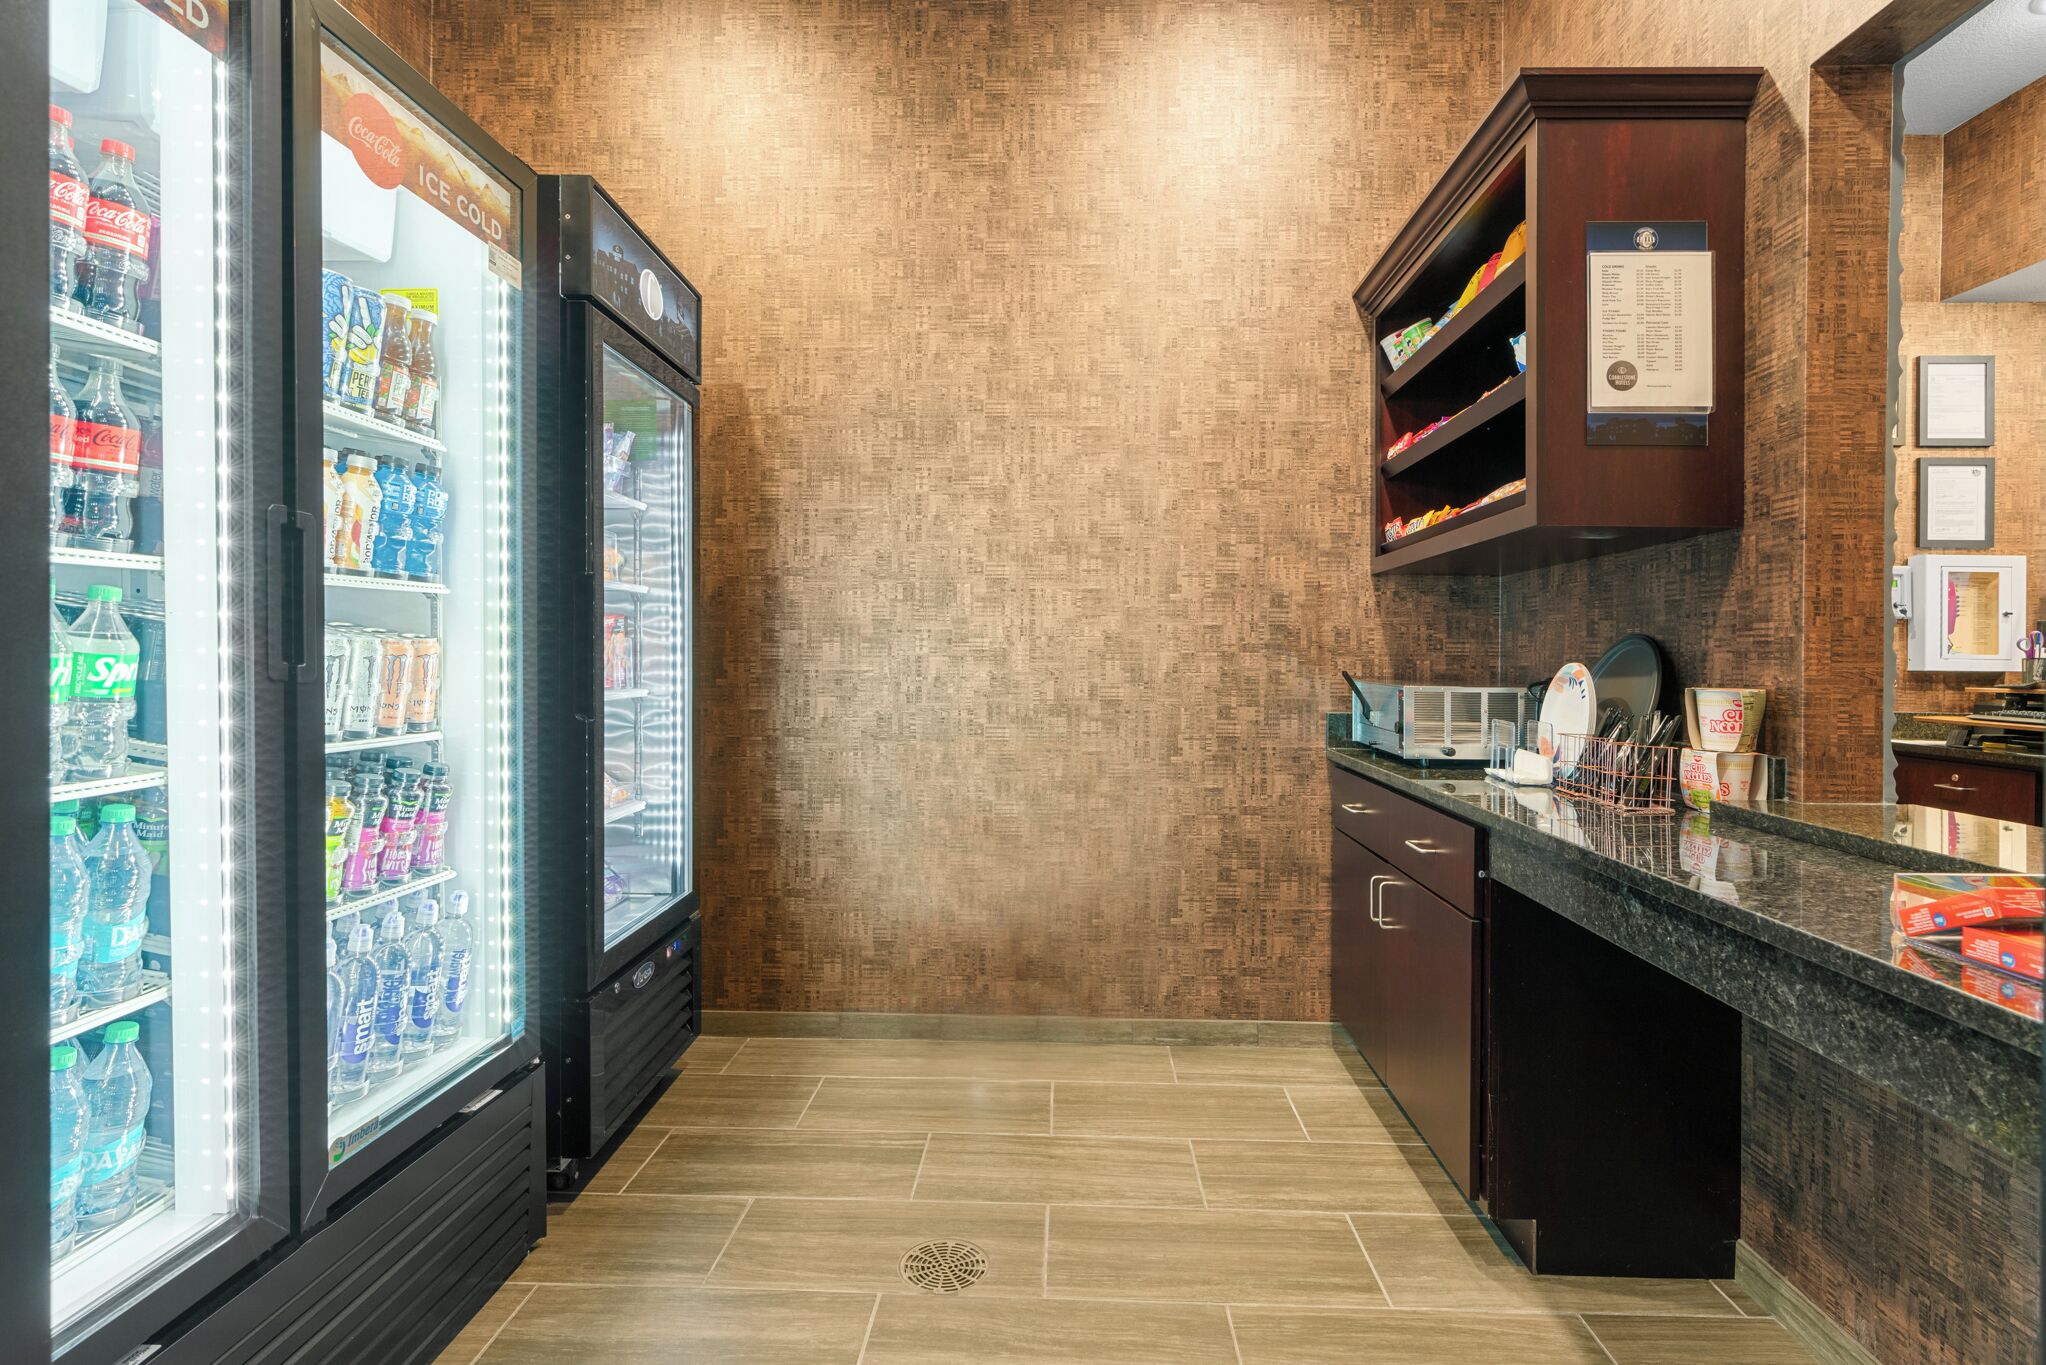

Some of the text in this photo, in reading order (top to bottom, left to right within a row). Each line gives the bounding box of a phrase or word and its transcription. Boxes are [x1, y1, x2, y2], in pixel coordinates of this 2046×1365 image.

[348, 115, 403, 168] Coca-Cola
[418, 164, 502, 240] ICE COLD
[1690, 763, 1706, 772] CUP
[354, 996, 374, 1056] smart
